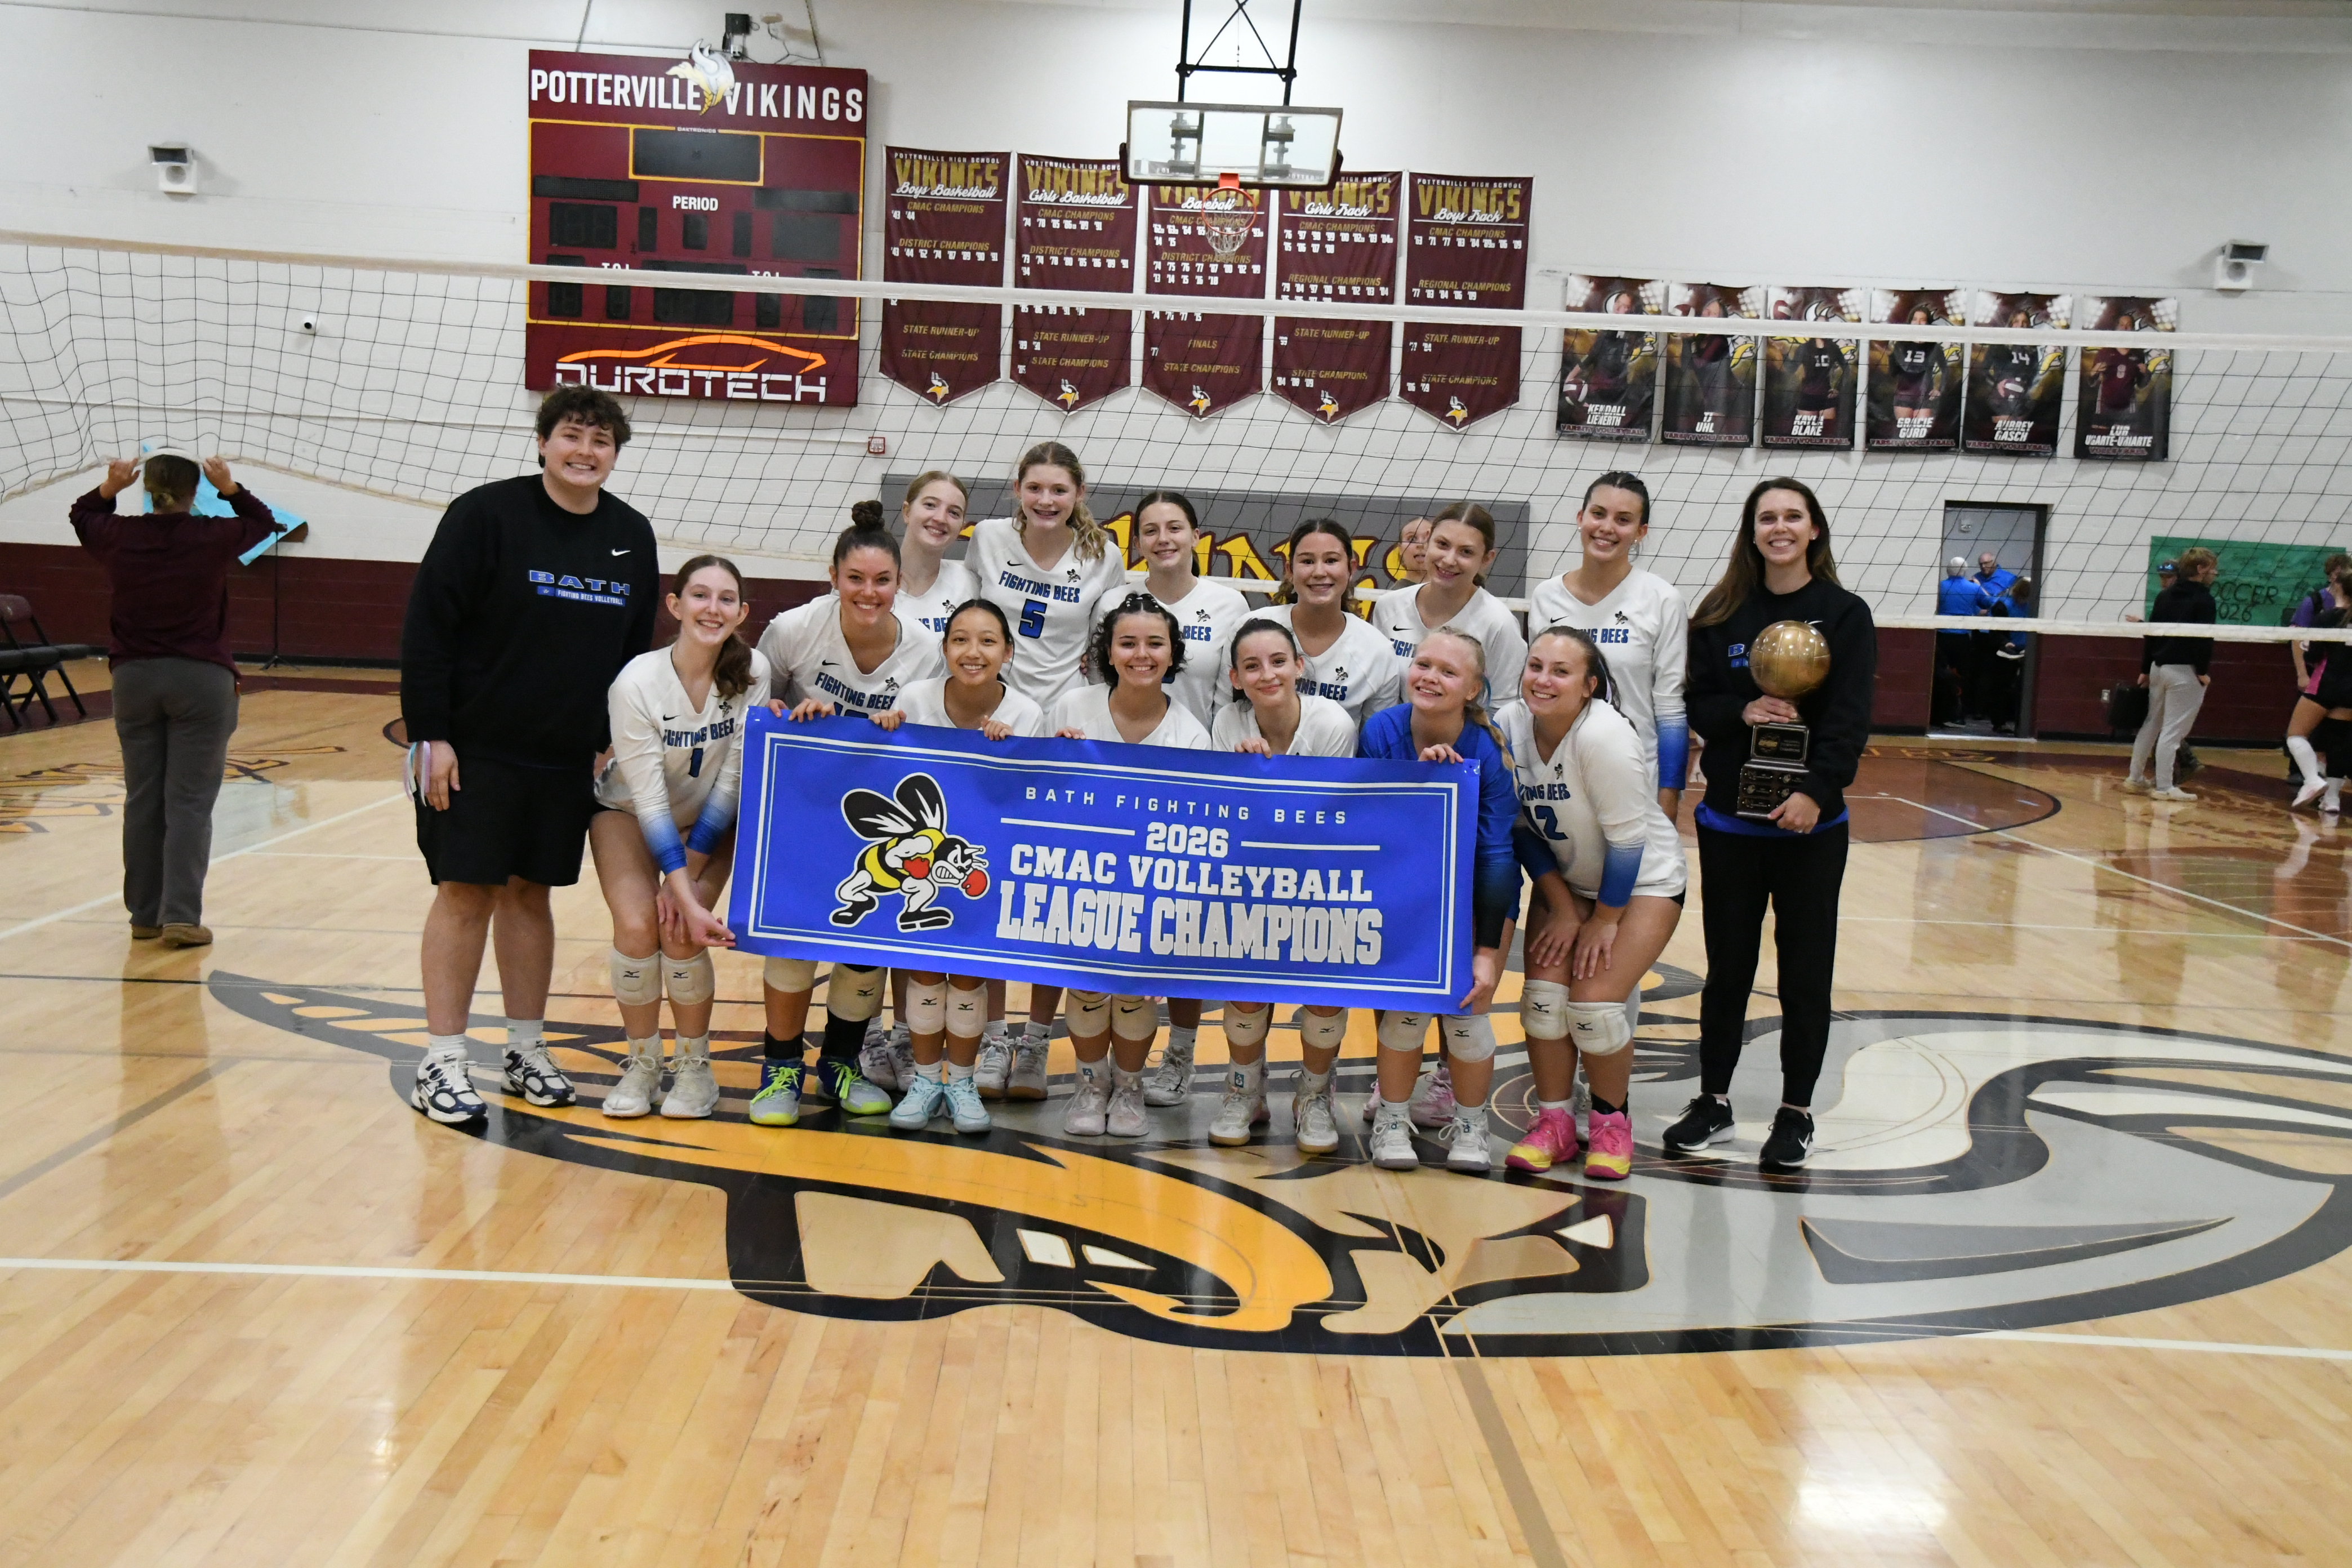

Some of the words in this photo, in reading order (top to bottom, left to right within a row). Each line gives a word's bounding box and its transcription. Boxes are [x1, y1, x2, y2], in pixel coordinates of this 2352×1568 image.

[531, 69, 702, 111] POTTERVILLE
[725, 82, 863, 122] VIKINGS
[894, 153, 945, 162] POTTERVILLE
[1025, 160, 1075, 169] POTTERVILLE
[896, 158, 999, 190] VIKINGS
[1418, 179, 1467, 187] POTTERVILLE
[896, 181, 930, 199] Boys
[930, 184, 997, 198] Basketball
[672, 195, 719, 211] PERIOD
[1029, 189, 1059, 202] Girls
[1059, 191, 1126, 206] Basketball
[1418, 185, 1520, 219] VIKINGS
[907, 202, 932, 211] CMAC
[934, 203, 985, 214] CHAMPIONS
[1305, 202, 1335, 215] Girls
[1335, 203, 1371, 217] Track
[892, 210, 901, 220] '43
[905, 211, 915, 221] '44
[1038, 209, 1063, 218] CMAC
[1065, 210, 1115, 221] CHAMPIONS
[1170, 215, 1194, 224] CMAC
[1434, 208, 1468, 225] Boys
[1468, 209, 1504, 222] Track
[1299, 221, 1324, 230] CMAC
[1326, 222, 1375, 233] CHAMPIONS
[1429, 228, 1453, 237] CMAC
[1456, 229, 1505, 238] CHAMPIONS
[899, 238, 938, 248] DISTRICT
[940, 240, 990, 251] CHAMPIONS
[905, 247, 914, 257] '44
[1030, 245, 1069, 256] DISTRICT
[1071, 248, 1120, 258] CHAMPIONS
[1161, 252, 1200, 262] DISTRICT
[1289, 274, 1329, 284] REGIONAL
[1332, 276, 1382, 286] CHAMPIONS
[1419, 279, 1459, 289] REGIONAL
[1462, 282, 1511, 292] CHAMPIONS
[903, 324, 929, 334] STATE
[930, 326, 979, 337] RUNNER-UP
[1295, 328, 1320, 337] STATE
[1321, 329, 1370, 339] RUNNER-UP
[1034, 332, 1059, 341] STATE
[1061, 333, 1110, 344] RUNNER-UP
[1451, 335, 1500, 345] RUNNER-UP
[1188, 340, 1218, 349] FINALS
[902, 349, 928, 359] STATE
[929, 350, 979, 361] CHAMPIONS
[1814, 355, 1829, 367] 10
[1904, 350, 1925, 363] 13
[2011, 351, 2030, 365] 14
[1031, 357, 1057, 366] STATE
[1059, 358, 1109, 368] CHAMPIONS
[1164, 363, 1189, 372] STATE
[1191, 364, 1240, 374] CHAMPIONS
[1292, 369, 1317, 378] STATE
[1319, 370, 1367, 380] CHAMPIONS
[1422, 374, 1447, 383] STATE
[1449, 376, 1498, 385] CHAMPIONS
[1587, 404, 1626, 416] KENDALL
[1703, 412, 1714, 422] TJ
[1793, 415, 1824, 425] KAYLA
[1896, 417, 1934, 428] GRACIE
[1695, 422, 1714, 433] UHL
[1791, 425, 1823, 436] BLAKE
[1994, 420, 2034, 431] AUBREY
[1994, 431, 2028, 442] GASCH
[529, 570, 630, 596] BATH
[999, 571, 1051, 598] FIGHTING
[1053, 585, 1080, 603] BEES
[558, 590, 580, 599] FIGHTING
[581, 593, 593, 602] BEES
[595, 595, 623, 605] VOLLEYBALL
[2210, 581, 2279, 605] OCCER
[2218, 602, 2252, 622] 026
[1018, 598, 1048, 639] 5
[1183, 625, 1211, 642] BEES
[1601, 628, 1629, 644] BEES
[814, 672, 866, 707] FIGHTING
[866, 694, 896, 710] BEES
[1319, 683, 1348, 701] BEES
[662, 727, 707, 747] FIGHTING
[710, 717, 735, 741] BEES
[688, 748, 703, 778] 1
[1026, 787, 1094, 805] BATH
[1116, 795, 1249, 820] FIGHTING
[1274, 809, 1347, 824] BEES
[1146, 822, 1230, 858] 2026
[1009, 844, 1117, 884] CMAC
[1128, 855, 1373, 902] VOLLEYBALL
[996, 880, 1145, 954] LEAGUE
[1150, 897, 1383, 965] CHAMPIONS
